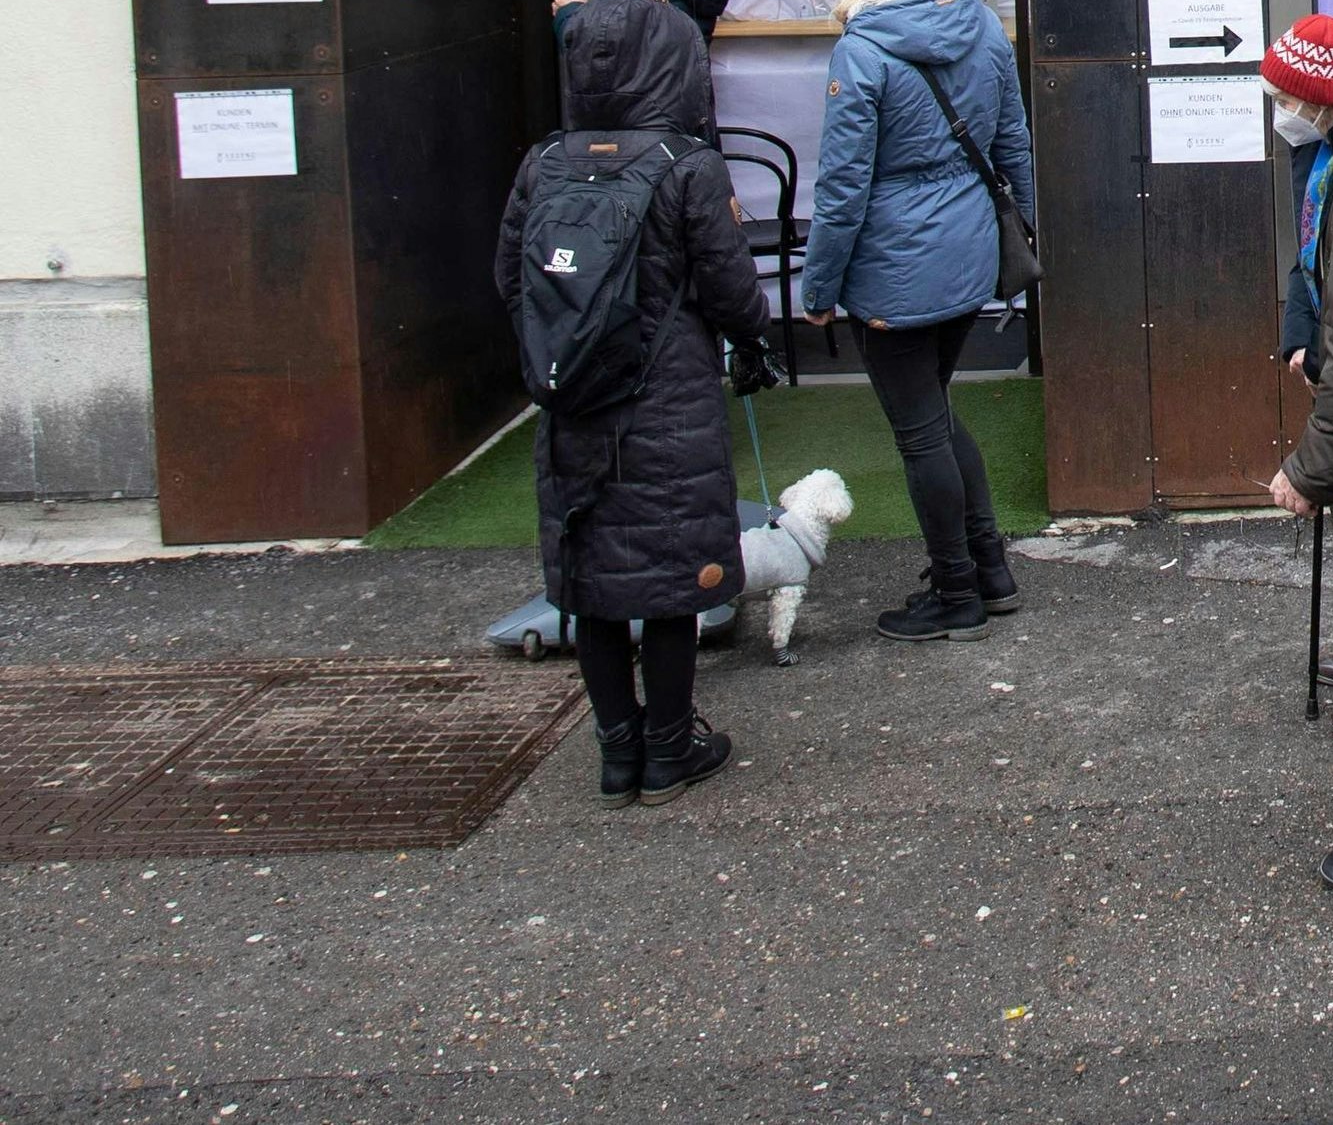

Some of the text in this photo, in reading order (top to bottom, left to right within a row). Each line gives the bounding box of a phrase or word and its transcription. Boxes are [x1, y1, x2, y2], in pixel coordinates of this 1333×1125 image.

[1187, 3, 1225, 13] AUSGABE
[1188, 94, 1223, 102] KUNDEN
[217, 108, 252, 117] KUNDEN
[1160, 109, 1183, 117] OHNE
[1221, 107, 1253, 115] TERMIN
